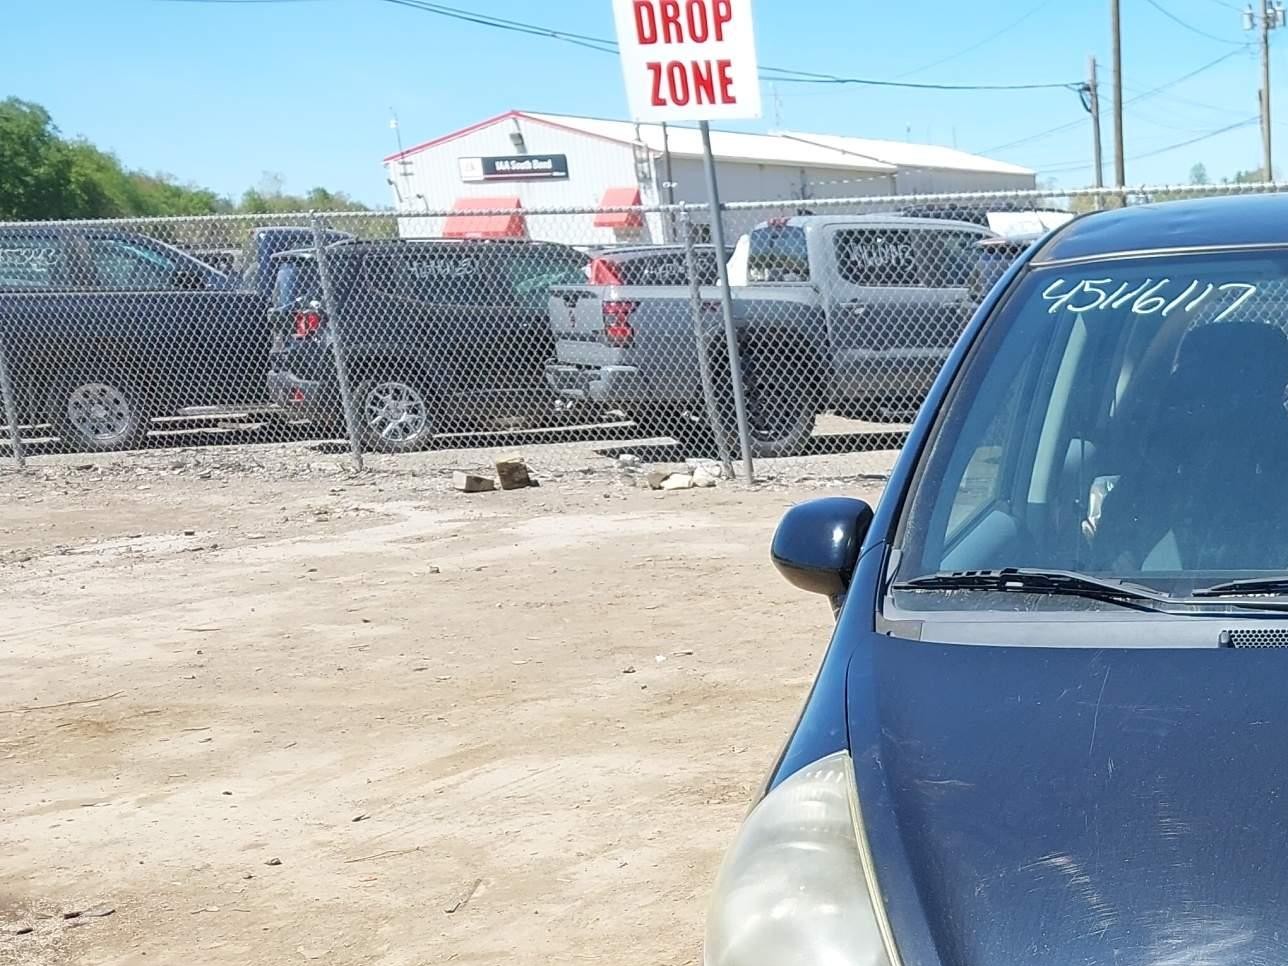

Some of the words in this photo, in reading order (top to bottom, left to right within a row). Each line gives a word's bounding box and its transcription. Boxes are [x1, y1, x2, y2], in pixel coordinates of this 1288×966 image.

[633, 0, 732, 44] DROP
[646, 59, 737, 106] ZONE
[1042, 277, 1257, 323] 45116117
